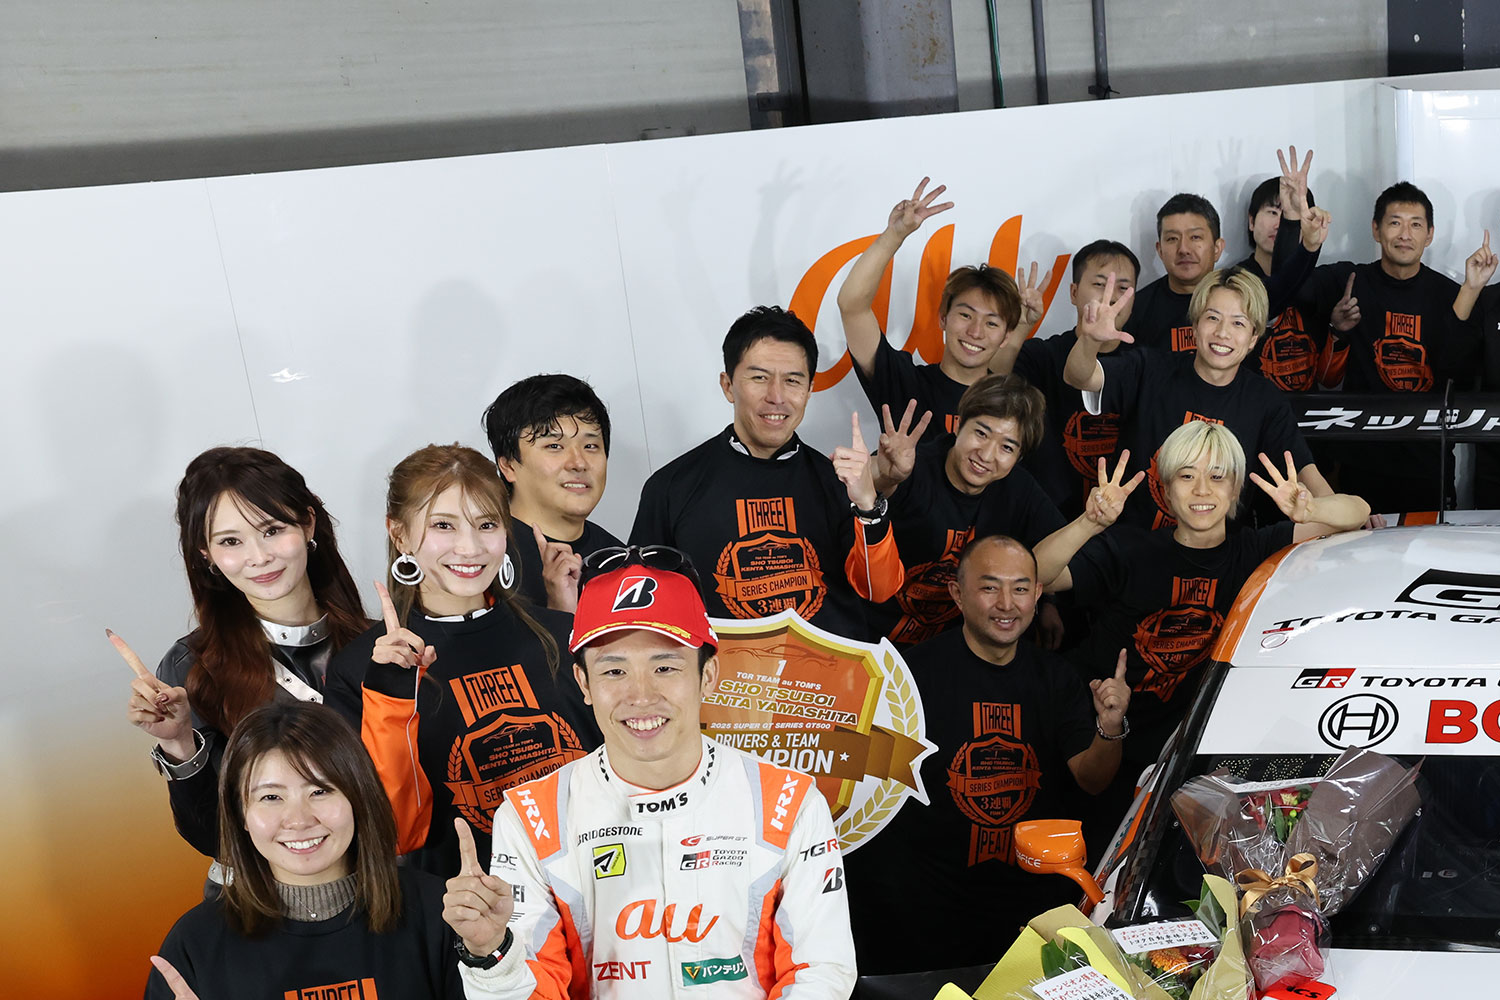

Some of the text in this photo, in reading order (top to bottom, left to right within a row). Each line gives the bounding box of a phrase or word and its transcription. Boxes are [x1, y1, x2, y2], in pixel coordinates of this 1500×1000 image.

[1393, 314, 1414, 335] THREE
[748, 500, 785, 528] THREE
[741, 575, 808, 597] SERIES CHAMPION
[1273, 608, 1437, 632] TOYOTA
[775, 659, 788, 677] 1
[1291, 668, 1356, 690] GR
[466, 670, 521, 712] THREE
[736, 671, 754, 680] TGR
[756, 674, 780, 684] TEAM
[795, 681, 822, 690] TOM'S
[1360, 676, 1487, 690] TOYOTA
[719, 680, 836, 707] SHO TSUBOI
[701, 693, 858, 726] ENTA YAMASHITA
[983, 705, 1011, 732] THREE
[715, 732, 821, 748] DRIVERS & TEAM
[478, 747, 556, 771] KENTA YAMASHITA
[489, 751, 509, 761] SHO
[510, 743, 543, 755] TSUBOI
[969, 776, 1024, 792] SERIES CHAMPION
[636, 792, 688, 813] TOM'S
[770, 773, 800, 831] HRX
[517, 789, 550, 840] HRX
[800, 838, 839, 862] TGR
[979, 829, 1010, 855] PEAT
[680, 851, 711, 870] GR
[712, 860, 743, 868] Racing
[615, 899, 719, 943] au
[594, 960, 651, 981] ZENT
[703, 962, 746, 978] バンテリン
